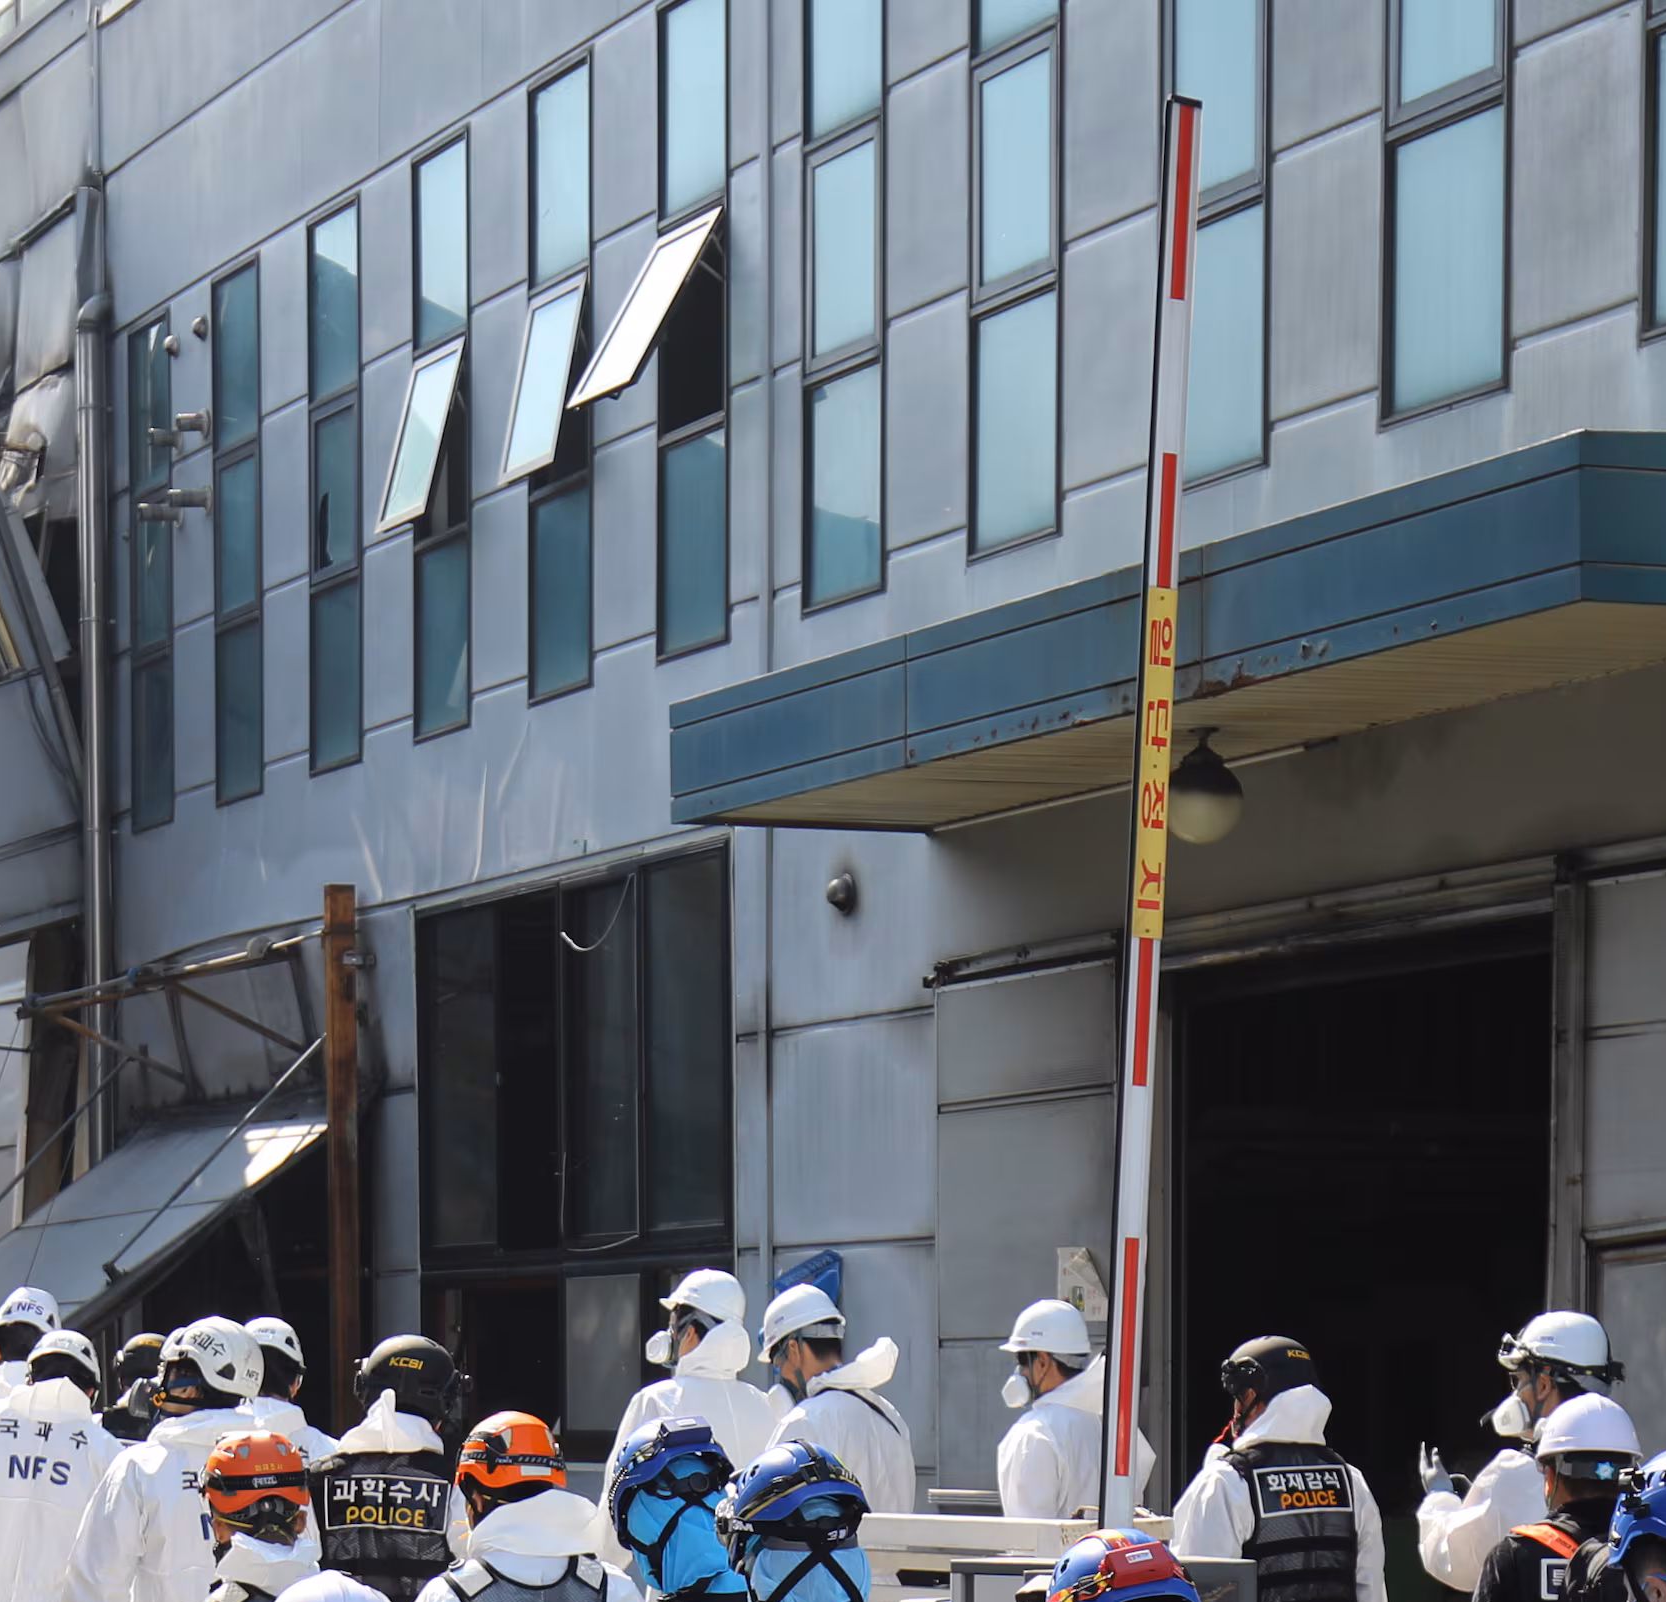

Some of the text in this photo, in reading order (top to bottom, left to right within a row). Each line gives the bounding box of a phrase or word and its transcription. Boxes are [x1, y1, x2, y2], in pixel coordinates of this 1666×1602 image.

[16, 1302, 45, 1316] NFS
[389, 1356, 424, 1370] KCSI
[8, 1455, 71, 1486] NFS
[1267, 1471, 1341, 1492] 화재감식
[333, 1478, 442, 1508] 과학수사
[1280, 1489, 1338, 1509] POLICE
[346, 1506, 426, 1527] POLICE
